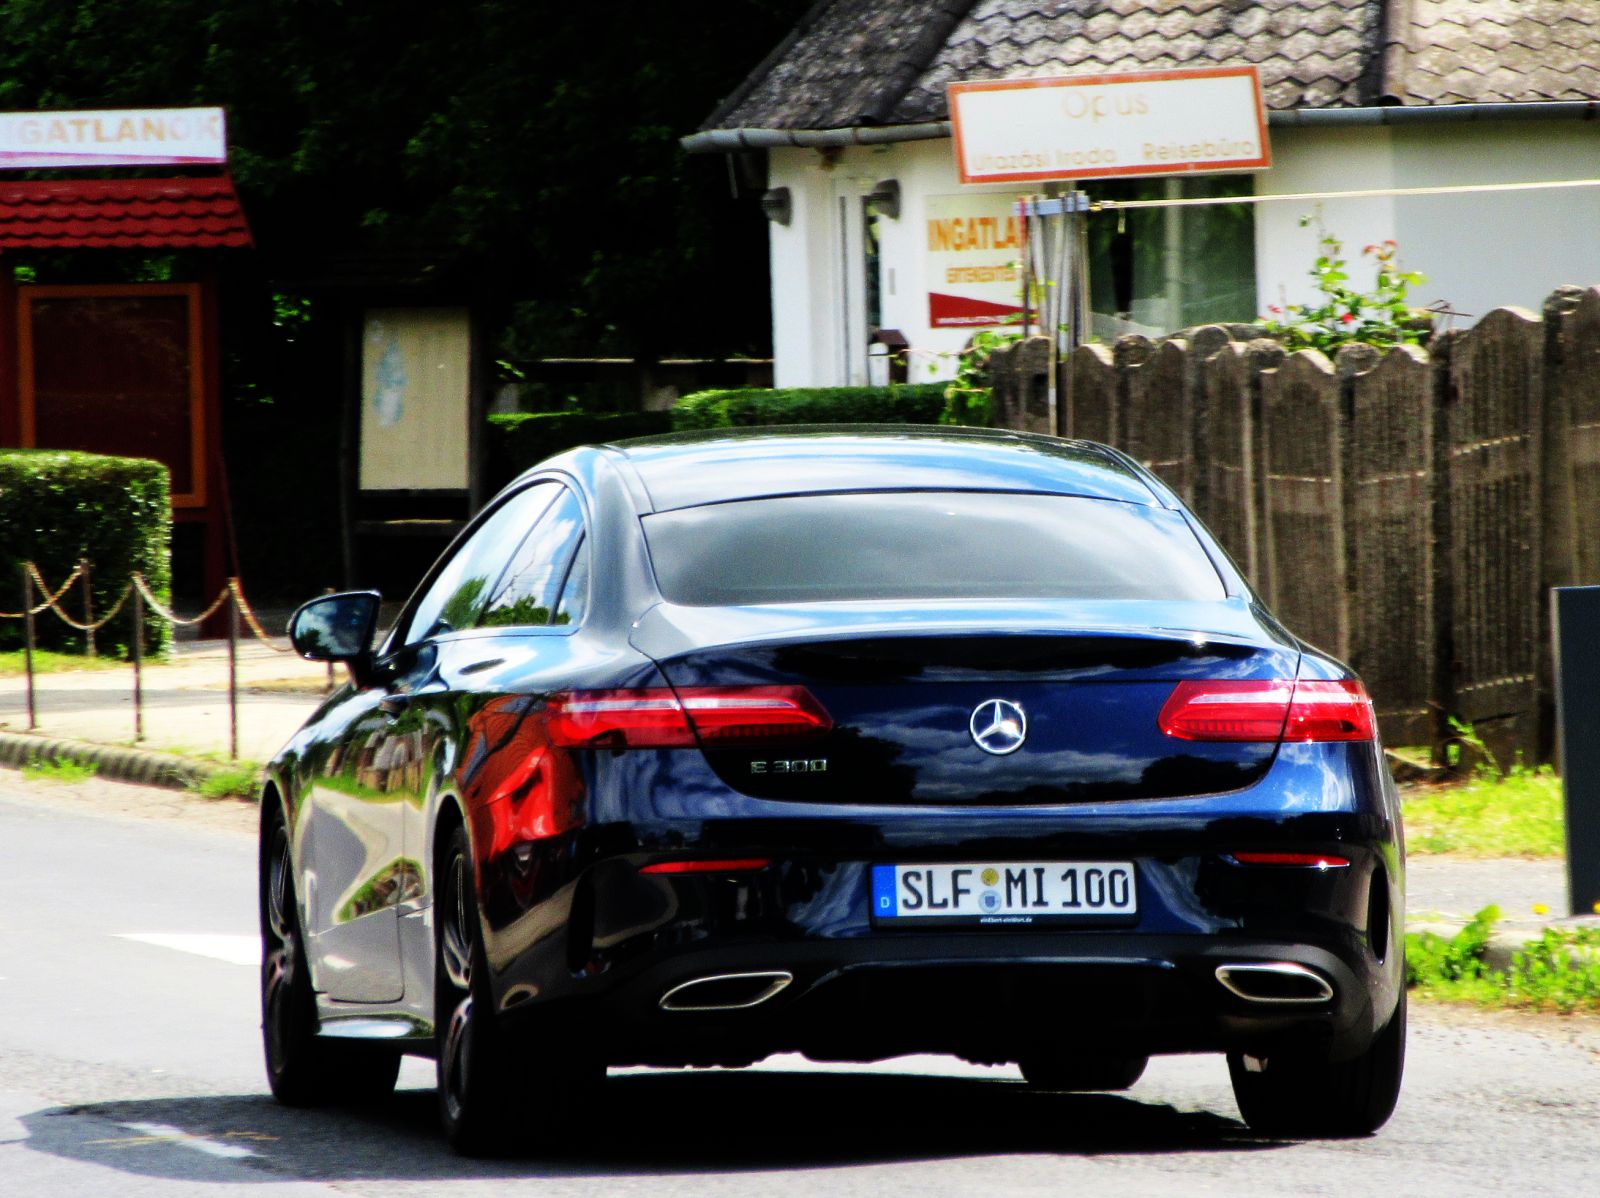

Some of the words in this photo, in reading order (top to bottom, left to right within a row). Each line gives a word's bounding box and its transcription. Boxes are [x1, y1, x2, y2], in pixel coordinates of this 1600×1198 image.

[1062, 91, 1150, 121] Opus
[751, 761, 767, 773] E
[773, 759, 827, 773] 300
[902, 869, 973, 910] SLF
[1005, 867, 1049, 908] MI
[1061, 868, 1130, 908] 100
[880, 896, 890, 909] D
